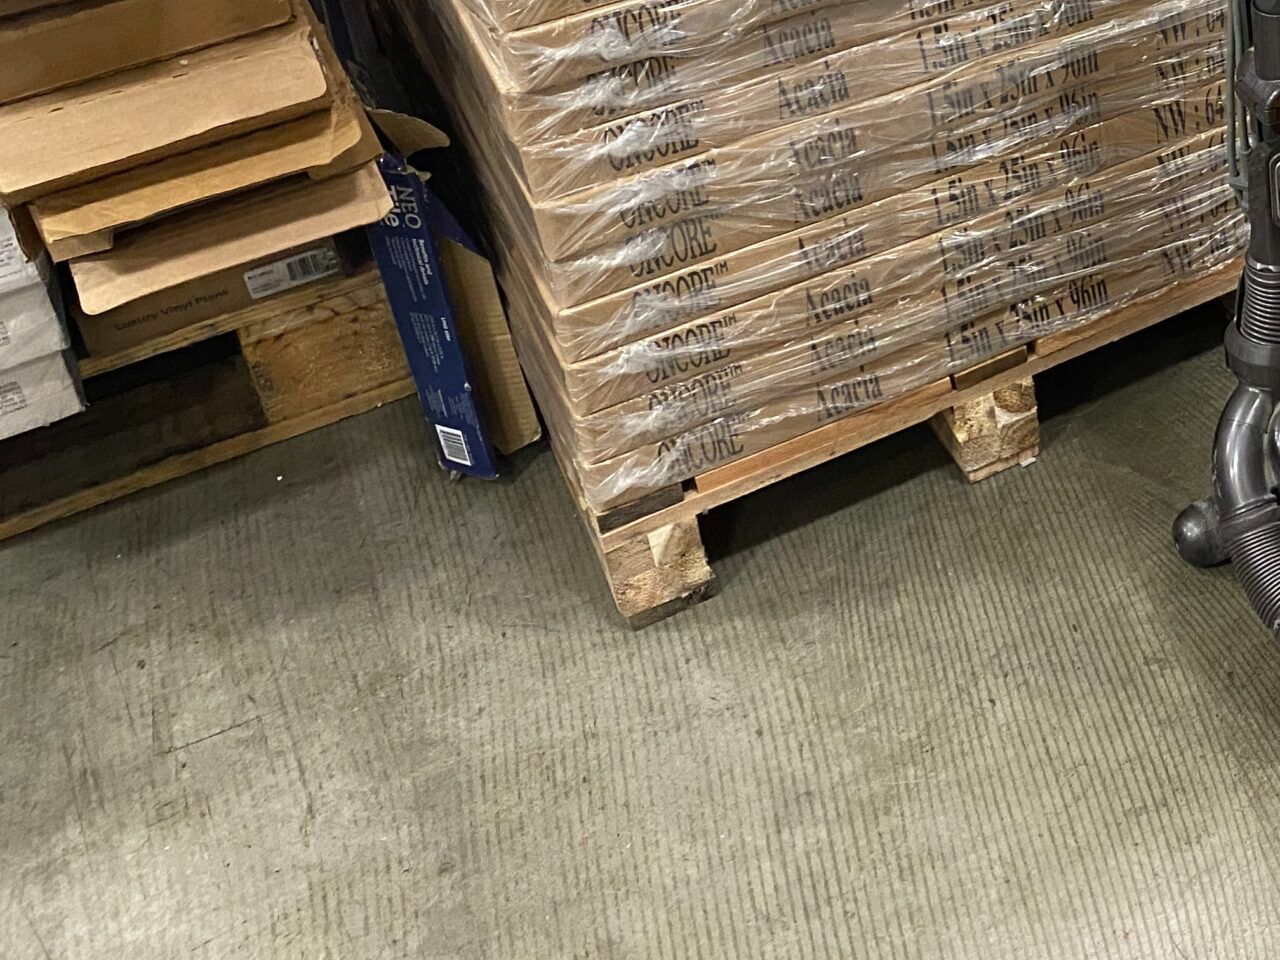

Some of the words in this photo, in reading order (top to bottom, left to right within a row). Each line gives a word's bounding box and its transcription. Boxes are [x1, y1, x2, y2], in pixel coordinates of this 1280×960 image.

[777, 61, 849, 120] Acacia
[396, 185, 421, 229] NEO
[115, 311, 159, 331] Luxury
[160, 299, 194, 316] Vinyl
[195, 290, 230, 305] Plank
[804, 273, 873, 328] Acacia
[815, 366, 883, 423] Acacia
